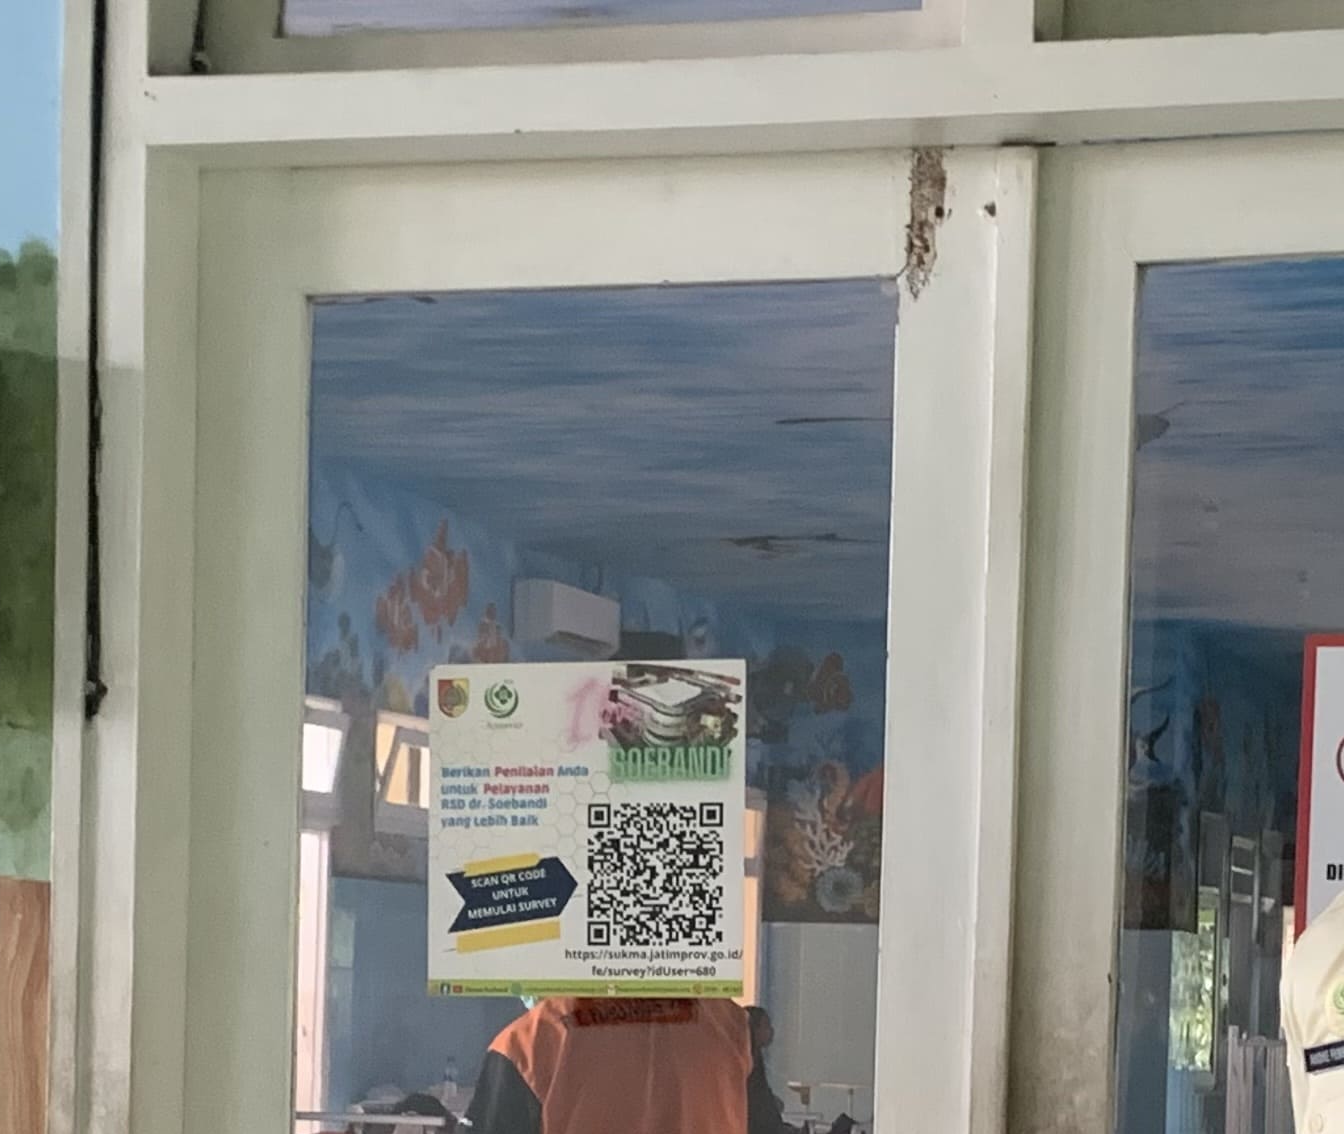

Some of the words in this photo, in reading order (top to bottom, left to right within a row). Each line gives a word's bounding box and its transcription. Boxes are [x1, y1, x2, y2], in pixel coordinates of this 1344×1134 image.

[612, 747, 729, 778] SOEBANDI
[441, 766, 490, 778] Berikan
[557, 765, 589, 777] Anda
[441, 784, 478, 795] untuk
[483, 783, 550, 796] Pelayanan
[441, 798, 466, 810] RSD
[487, 797, 547, 810] Soebandi
[441, 816, 471, 828] yang
[511, 815, 539, 826] Baik
[471, 874, 499, 888] SCAN
[500, 872, 517, 885] QR
[518, 868, 547, 881] CODE
[491, 886, 529, 900] UNTUK
[467, 902, 517, 919] MEMULAI
[518, 896, 558, 912] SURVEY
